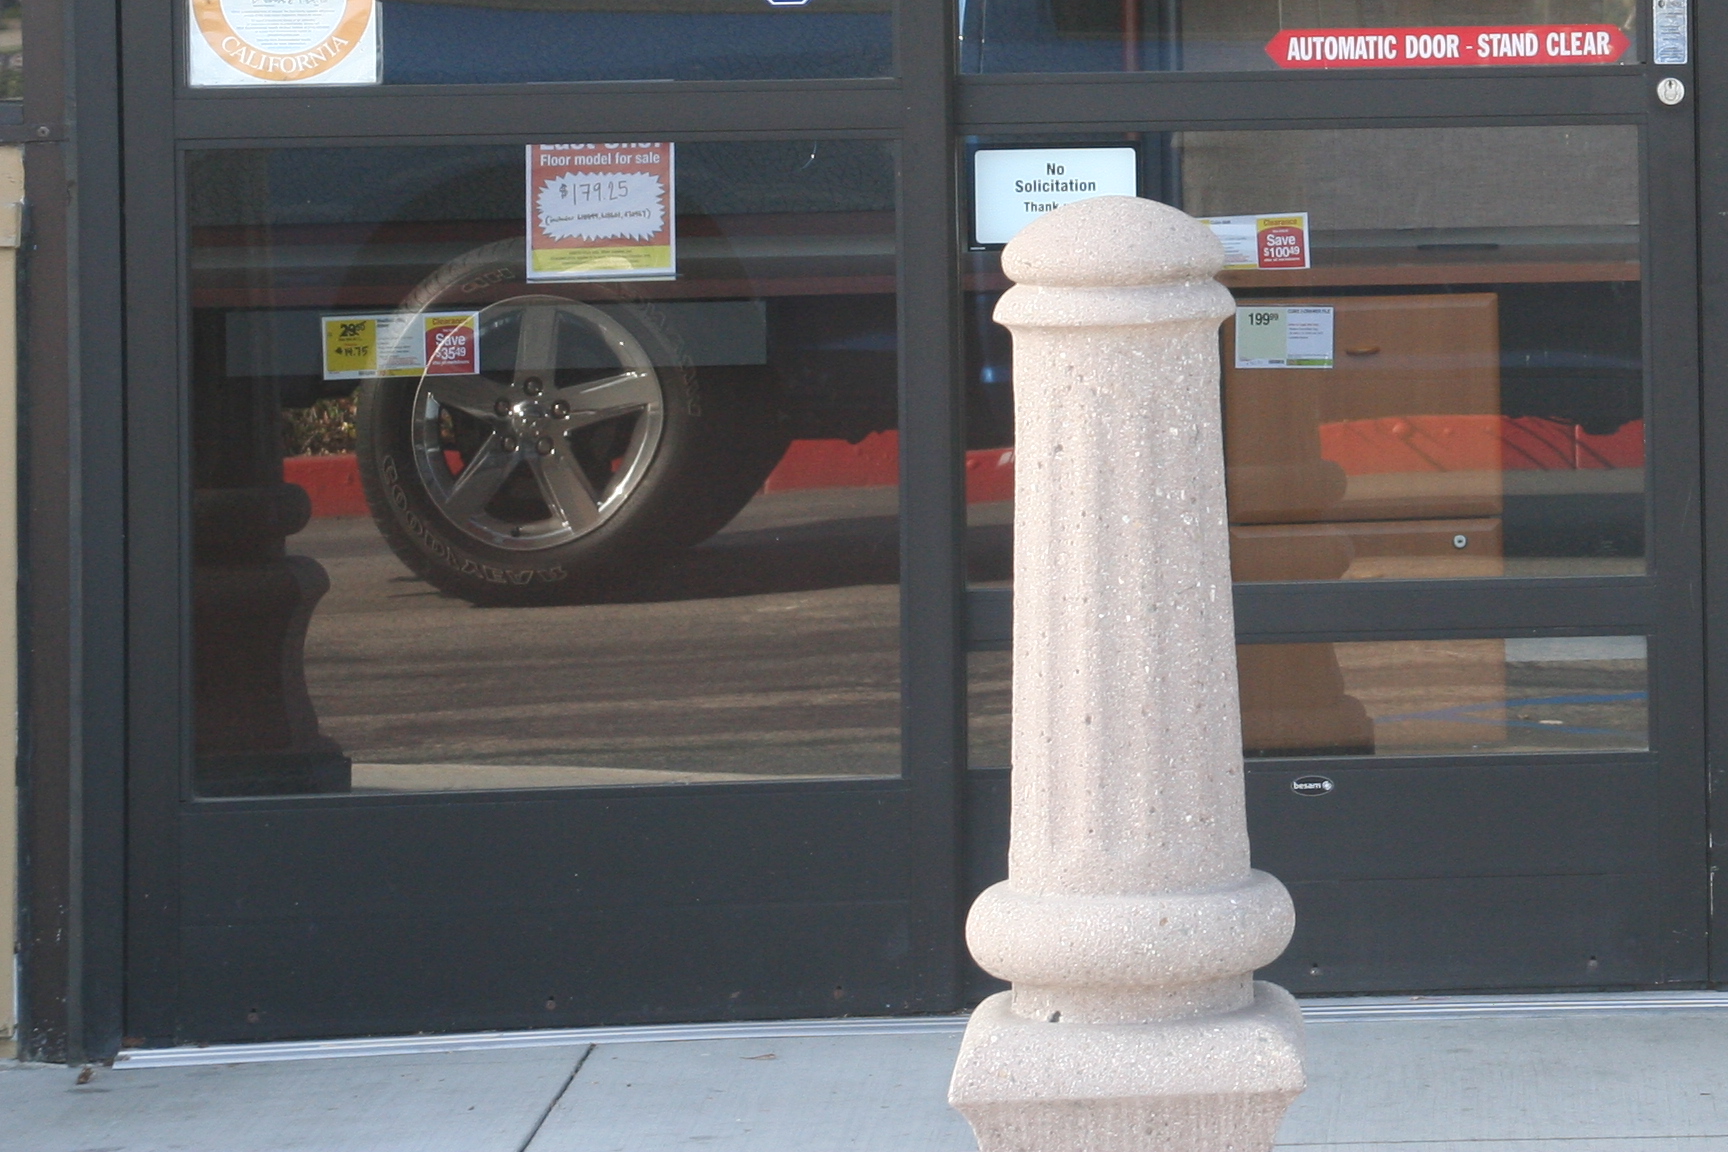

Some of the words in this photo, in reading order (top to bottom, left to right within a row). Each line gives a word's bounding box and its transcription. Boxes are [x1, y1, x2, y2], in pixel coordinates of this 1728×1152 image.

[1287, 35, 1397, 60] AUTOMATIC
[1405, 34, 1460, 59] DOOR
[1477, 32, 1539, 58] STAND
[1546, 31, 1610, 56] CLEAR
[221, 35, 349, 73] CALIFORNIA
[540, 154, 571, 166] Floor
[574, 153, 611, 165] model
[615, 152, 632, 164] for
[635, 151, 660, 163] sale
[1046, 163, 1065, 176] No
[559, 180, 629, 205] $179.25
[1015, 179, 1097, 193] Solicitation
[1024, 201, 1059, 213] Thank
[1267, 234, 1296, 246] Save
[435, 333, 466, 346] Save
